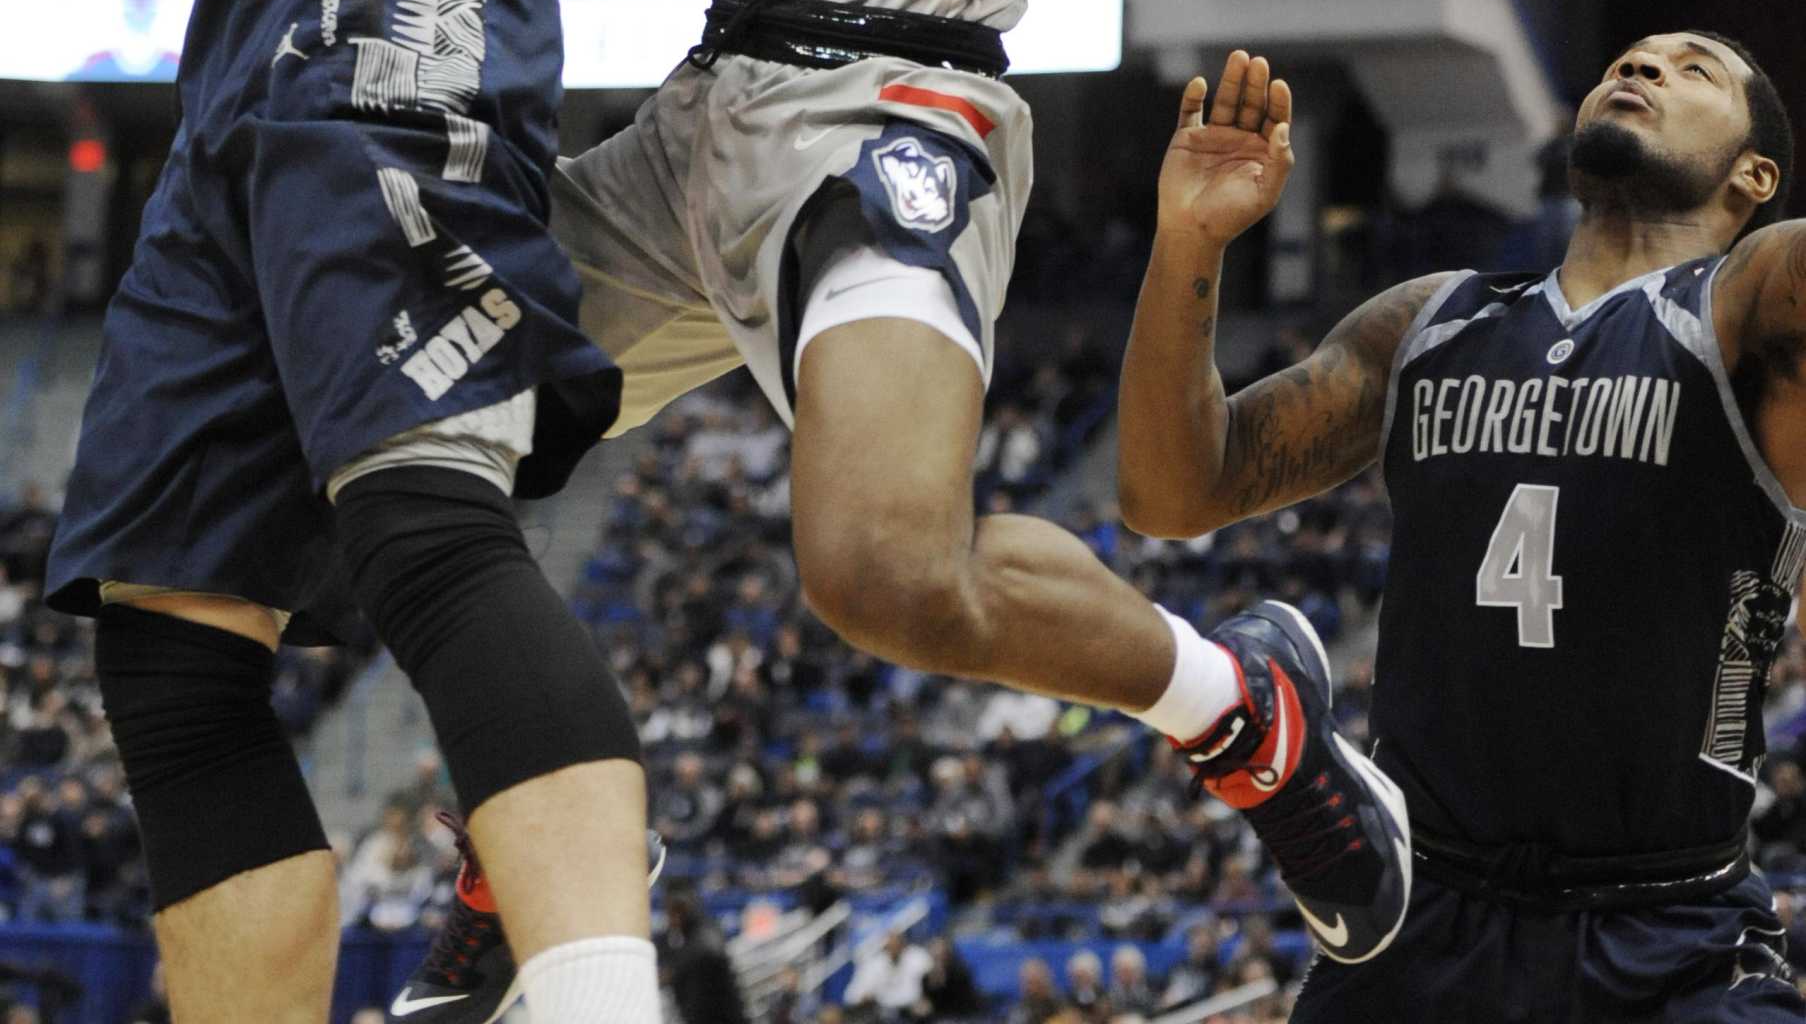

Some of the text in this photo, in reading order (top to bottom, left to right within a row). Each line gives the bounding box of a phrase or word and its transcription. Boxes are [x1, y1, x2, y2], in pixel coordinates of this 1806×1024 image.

[400, 288, 521, 401] HOYAS
[1411, 374, 1681, 466] GEORGETOWN
[1475, 483, 1563, 648] 4
